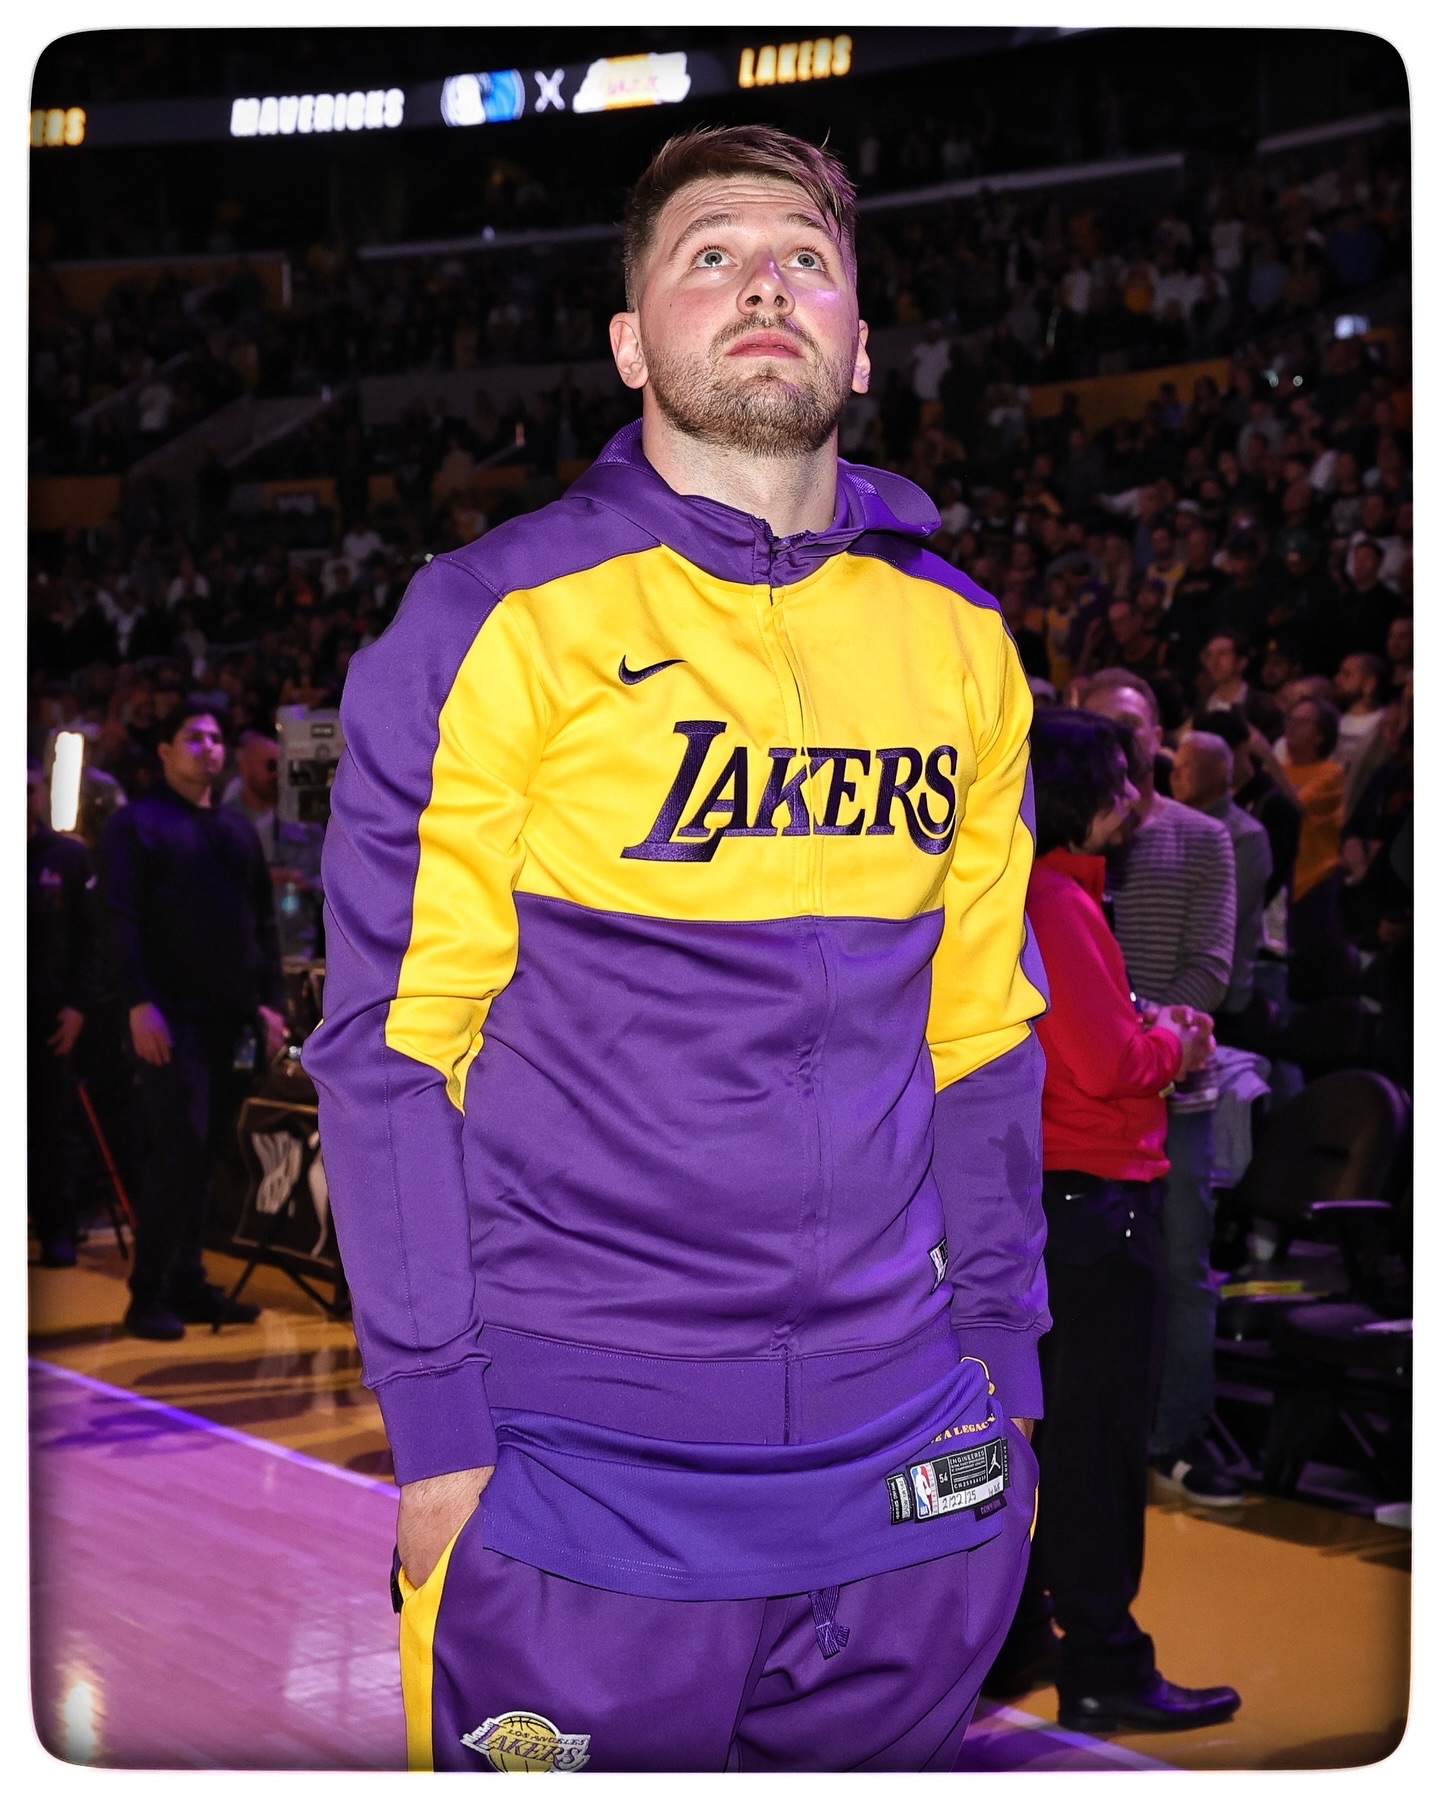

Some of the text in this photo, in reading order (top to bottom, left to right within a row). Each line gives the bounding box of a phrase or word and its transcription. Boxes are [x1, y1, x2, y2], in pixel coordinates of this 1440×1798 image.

[739, 34, 852, 88] LAKERS
[230, 88, 404, 136] MAVERICKS
[620, 720, 958, 863] LAKERS
[944, 1430, 952, 1440] A
[938, 1474, 948, 1483] 54
[941, 1491, 977, 1511] 2/22/25
[473, 1723, 585, 1771] LAKERS
[507, 1729, 585, 1746] LOS ANGELES
